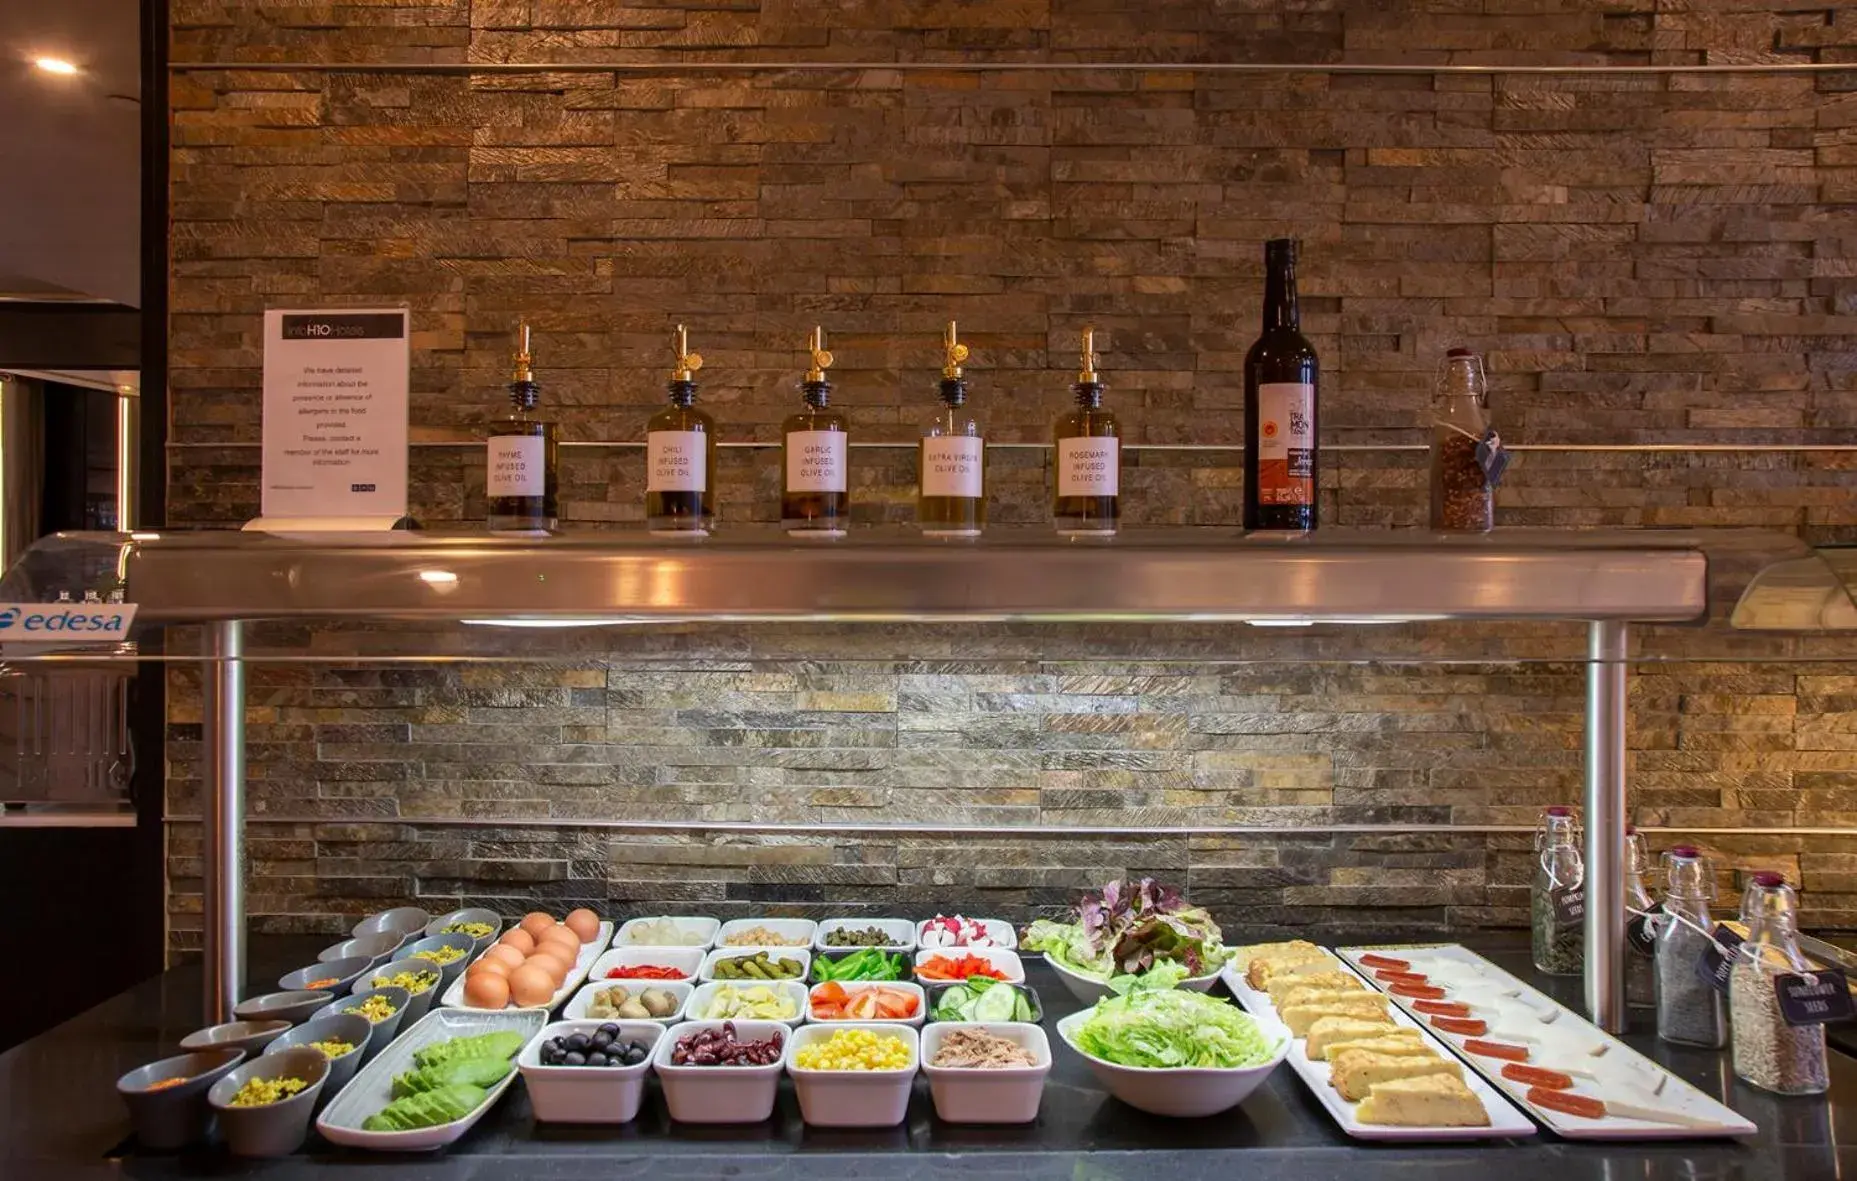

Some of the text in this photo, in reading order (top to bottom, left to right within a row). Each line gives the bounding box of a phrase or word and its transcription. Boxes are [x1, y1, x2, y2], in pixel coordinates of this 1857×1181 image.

[804, 445, 832, 454] GARLIC
[801, 457, 834, 465] INFUSED
[935, 464, 957, 472] OLIVE
[1072, 462, 1105, 470] INFUSED
[494, 473, 512, 481] OLIVE
[800, 469, 822, 477] OLIVE
[1071, 473, 1093, 481] OLIVE
[24, 610, 122, 631] edesa
